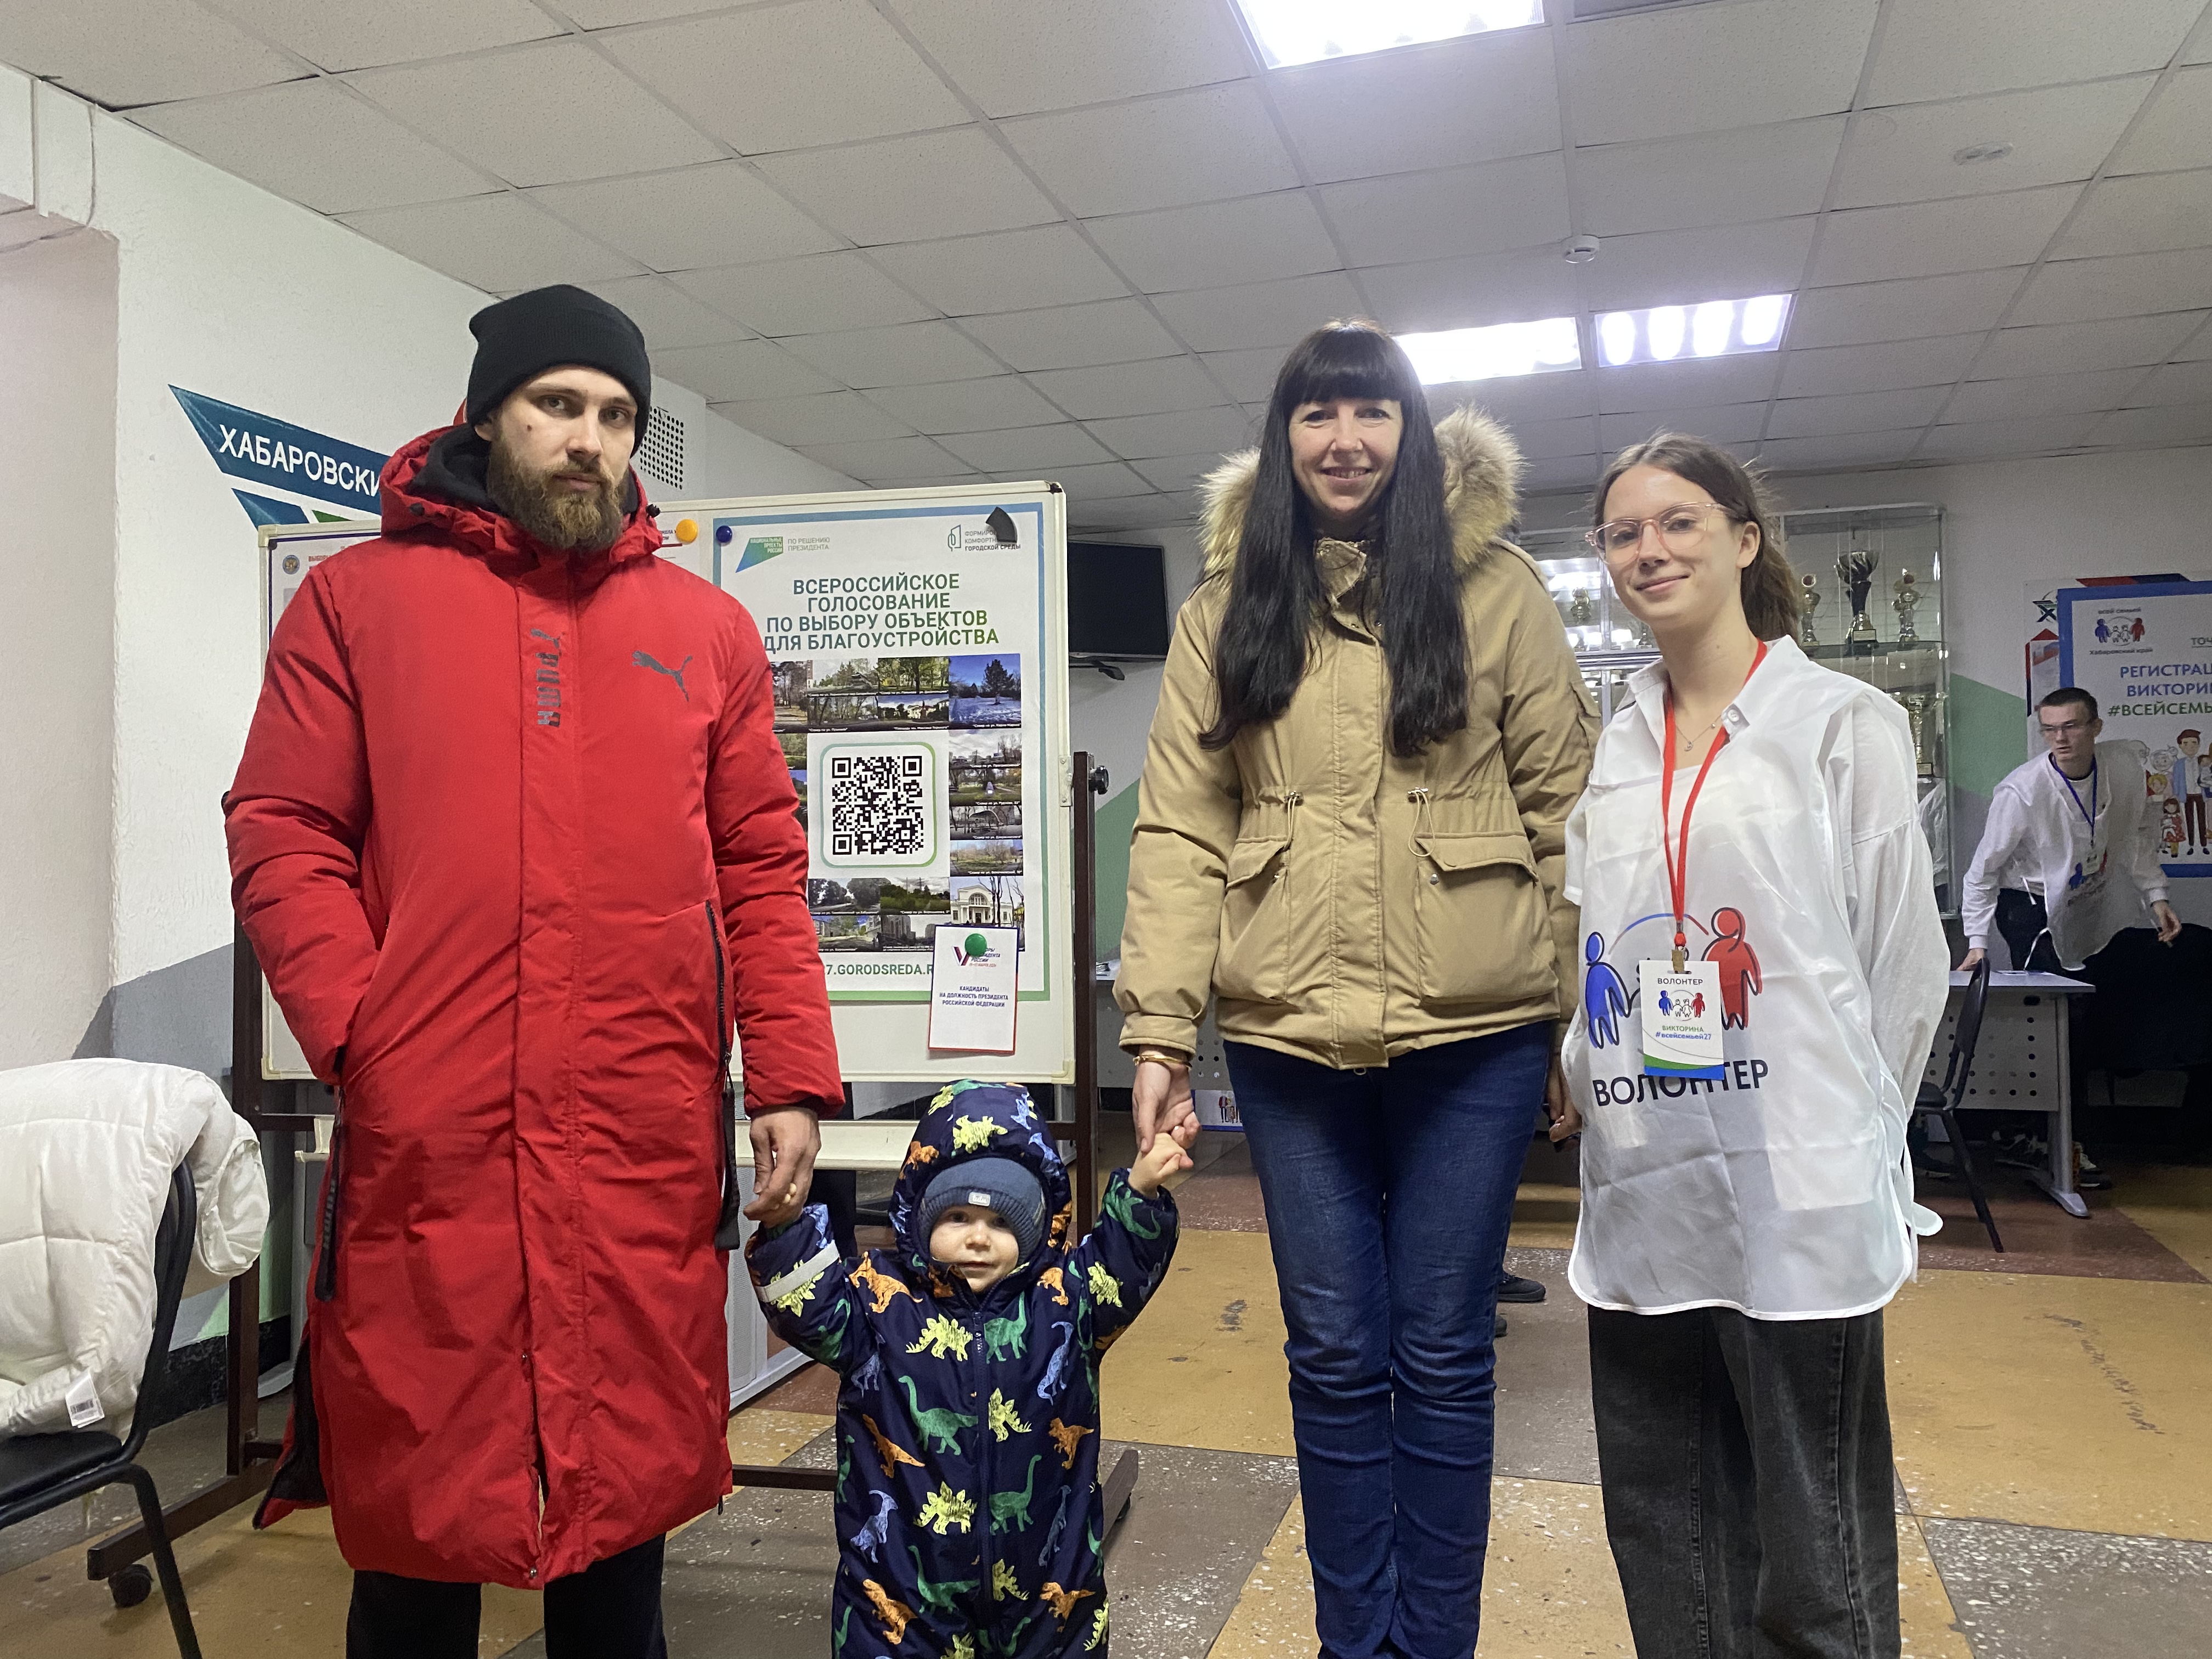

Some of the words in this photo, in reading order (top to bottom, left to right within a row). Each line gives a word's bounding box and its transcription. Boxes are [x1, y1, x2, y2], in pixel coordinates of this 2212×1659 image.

[793, 572, 960, 595] ВСЕРОССИЙСКОЕ
[808, 592, 950, 613] ГОЛОСОВАНИЕ
[767, 617, 792, 633] ПО
[799, 614, 878, 632] ВЫБОРУ
[885, 610, 988, 629] ОБЪЕКТОВ
[764, 635, 801, 654] ДЛЯ
[808, 627, 999, 650] БЛАГОУСТРОЙСТВА
[535, 652, 561, 727] PUMA
